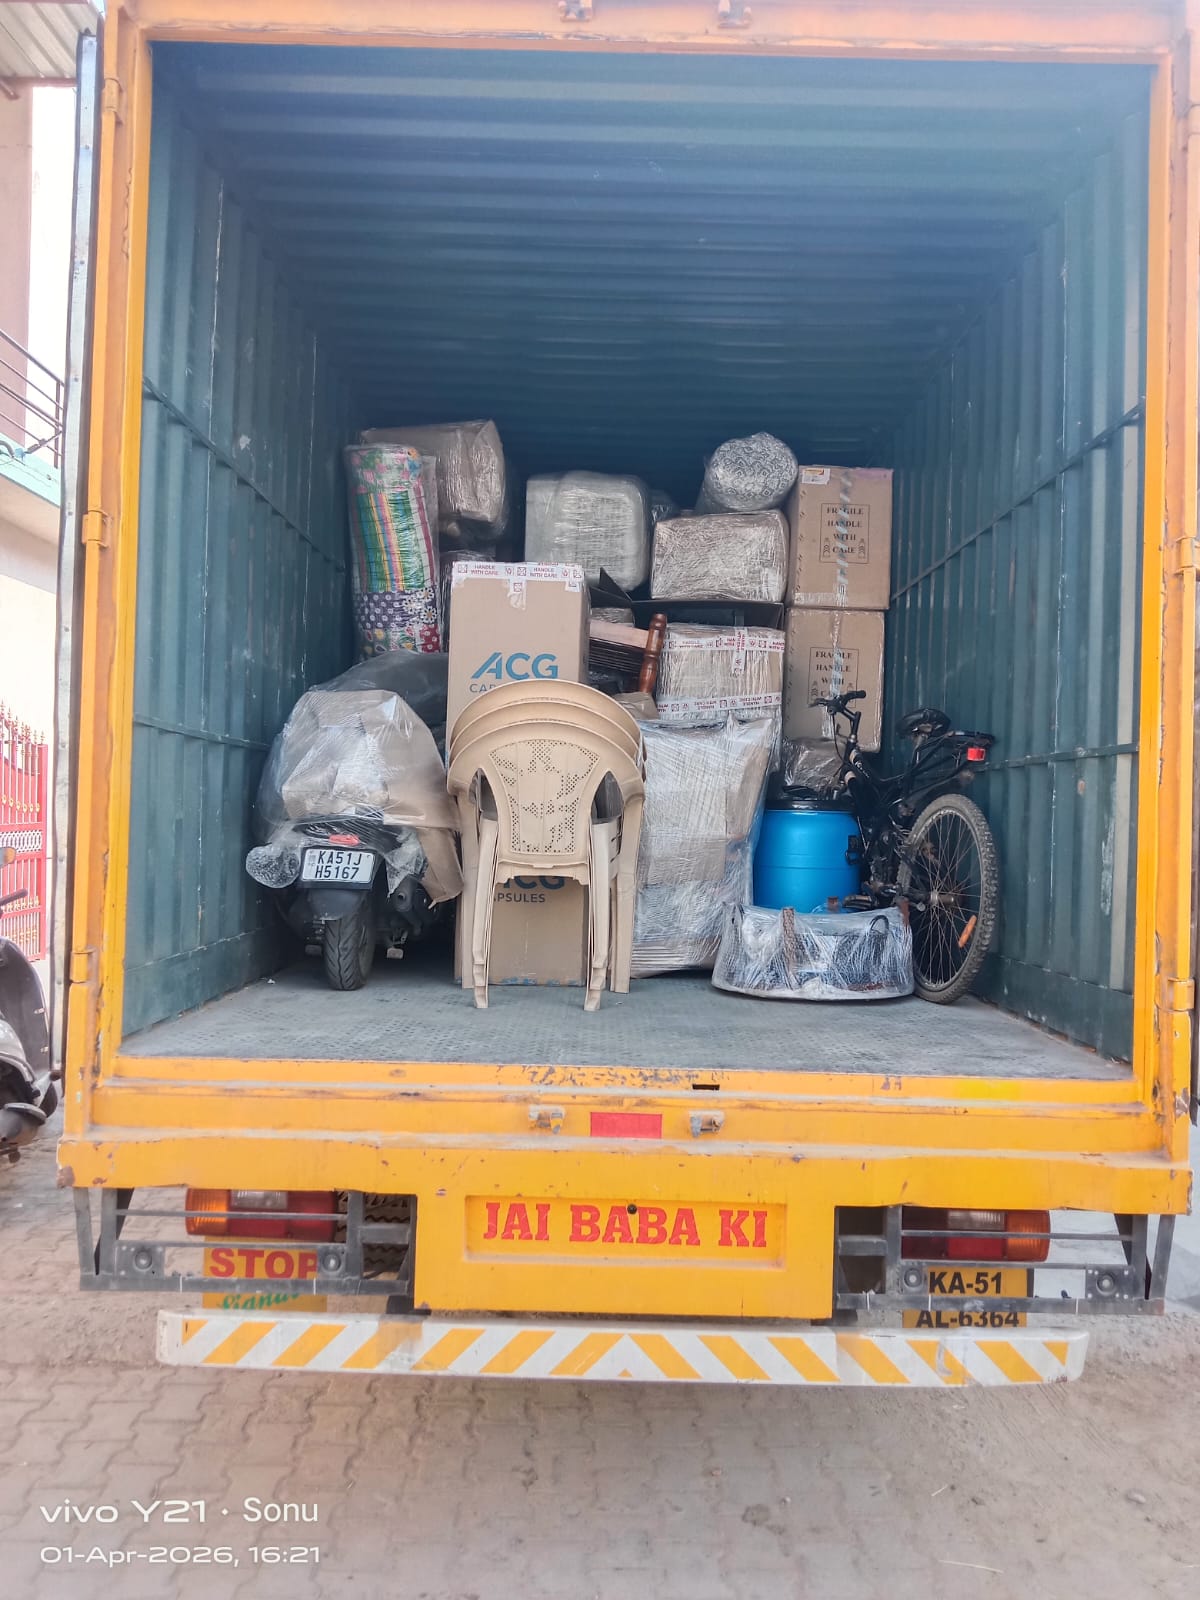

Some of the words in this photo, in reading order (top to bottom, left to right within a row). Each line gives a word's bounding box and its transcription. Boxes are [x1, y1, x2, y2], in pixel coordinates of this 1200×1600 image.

[470, 652, 559, 680] ACG
[318, 851, 362, 866] KA51J
[315, 865, 360, 880] H5167
[494, 892, 545, 903] PSULES
[483, 1202, 550, 1241] JAI
[569, 1204, 701, 1246] BABA
[718, 1208, 768, 1248] KI
[209, 1247, 318, 1279] STOP
[929, 1271, 1002, 1295] KA-51
[915, 1310, 1020, 1329] AL-6364
